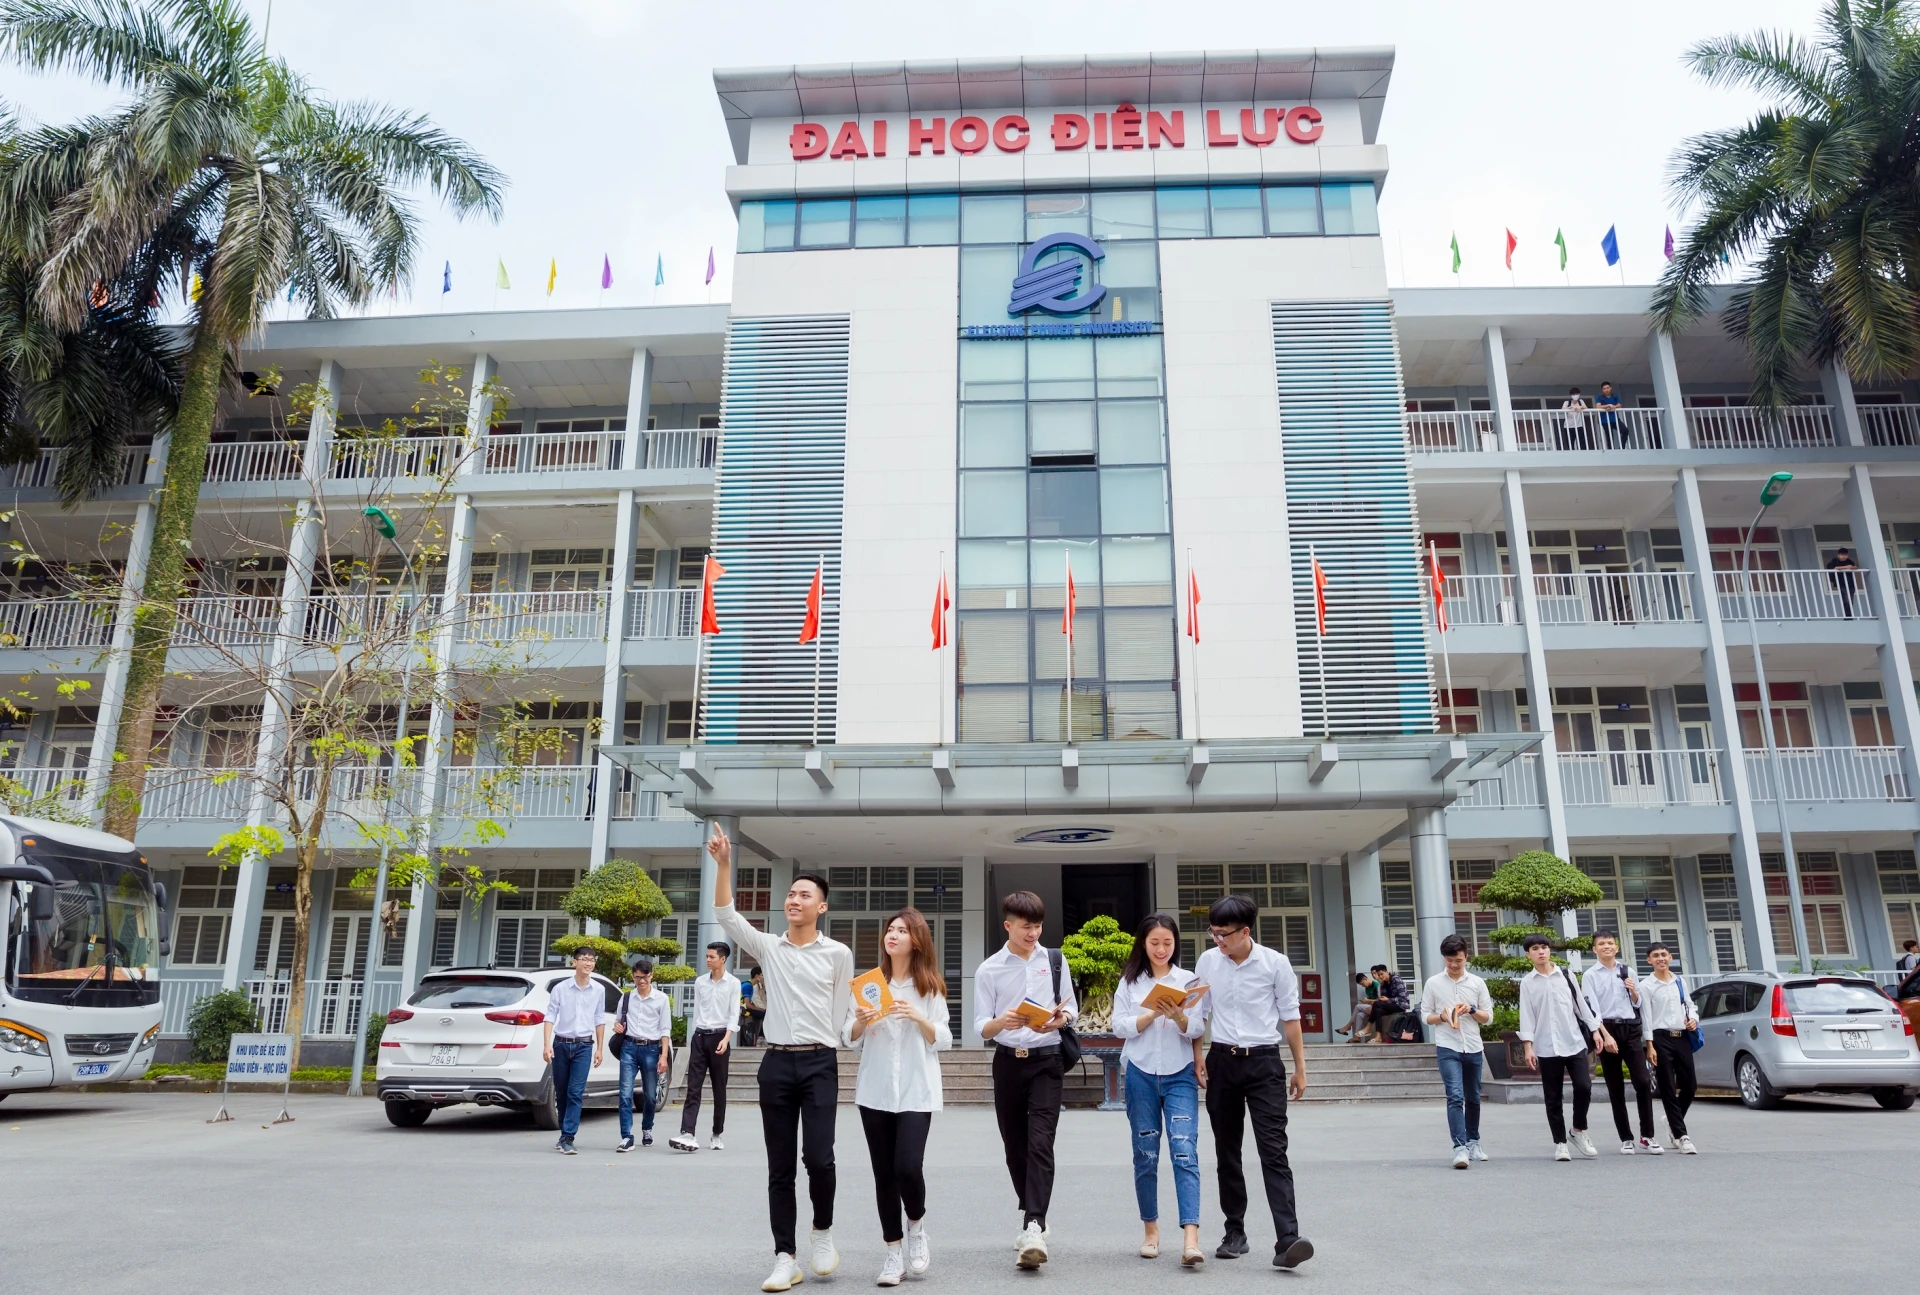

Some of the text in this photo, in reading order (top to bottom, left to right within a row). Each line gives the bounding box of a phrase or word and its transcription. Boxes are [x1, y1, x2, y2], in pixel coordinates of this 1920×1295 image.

[790, 103, 1324, 161] ĐẠI HỌC ĐIỆN LỰC
[967, 321, 1153, 338] ELECTRIC POWER UNIVERSITY
[1846, 1031, 1863, 1041] 29A
[438, 1046, 453, 1055] 30F
[1844, 1040, 1869, 1049] 54017
[236, 1044, 248, 1056] KHU
[249, 1044, 260, 1058] VỰC
[268, 1045, 276, 1056] XE
[276, 1044, 287, 1056] ÔTÔ
[430, 1055, 456, 1065] 784.91
[229, 1059, 246, 1073] GIẢNG
[246, 1061, 259, 1074] VIÊN
[263, 1063, 275, 1076] HỌC
[275, 1061, 288, 1074] VIÊN
